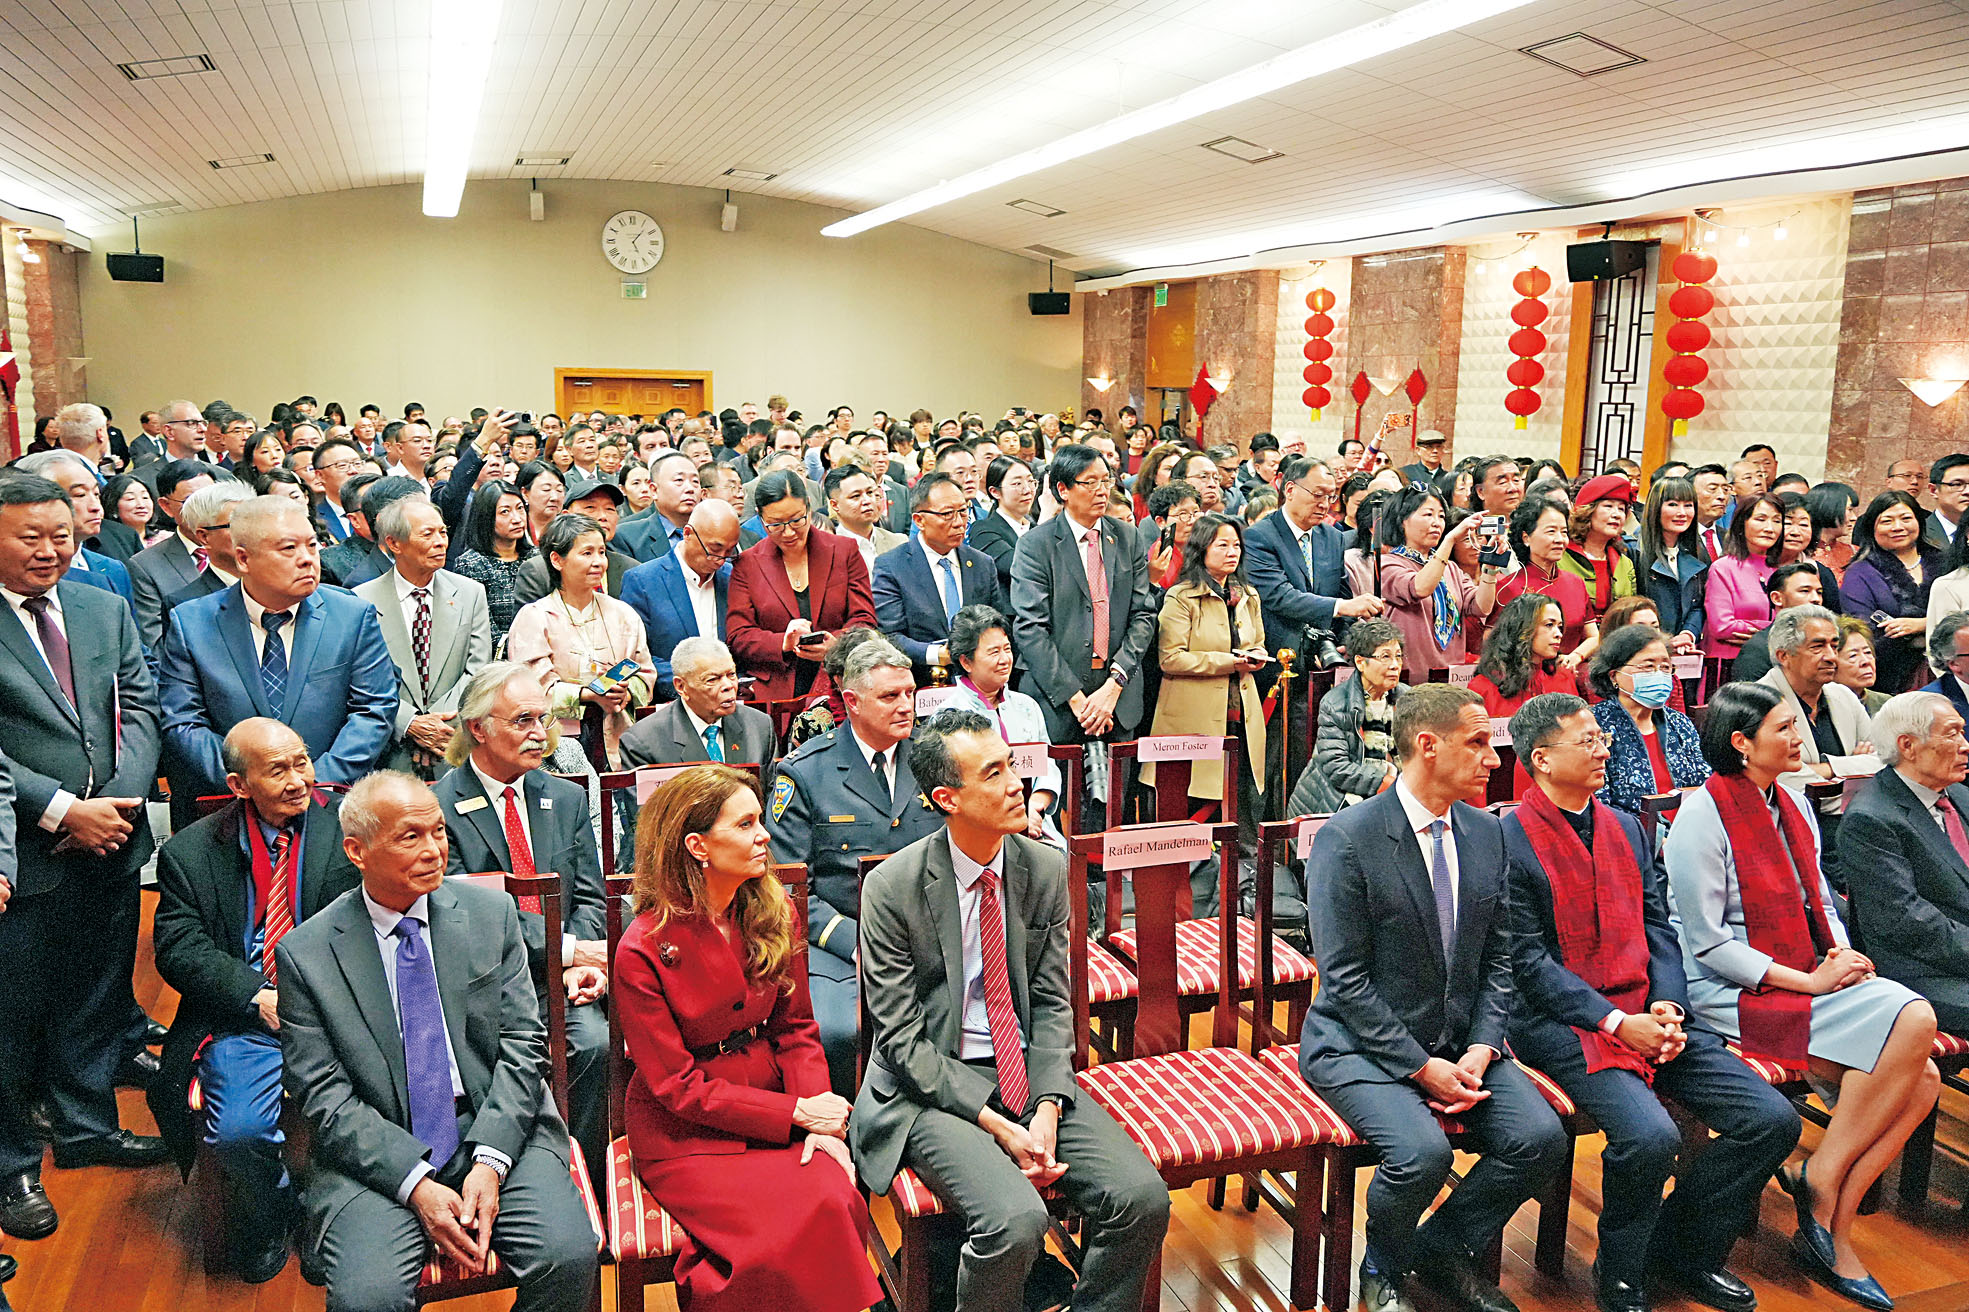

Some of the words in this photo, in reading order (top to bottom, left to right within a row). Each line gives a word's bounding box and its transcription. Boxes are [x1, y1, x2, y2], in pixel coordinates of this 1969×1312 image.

[1152, 742, 1180, 752] Meron
[1182, 741, 1209, 751] Foster
[1108, 842, 1143, 857] Rafael
[1146, 837, 1209, 853] Mandelman
